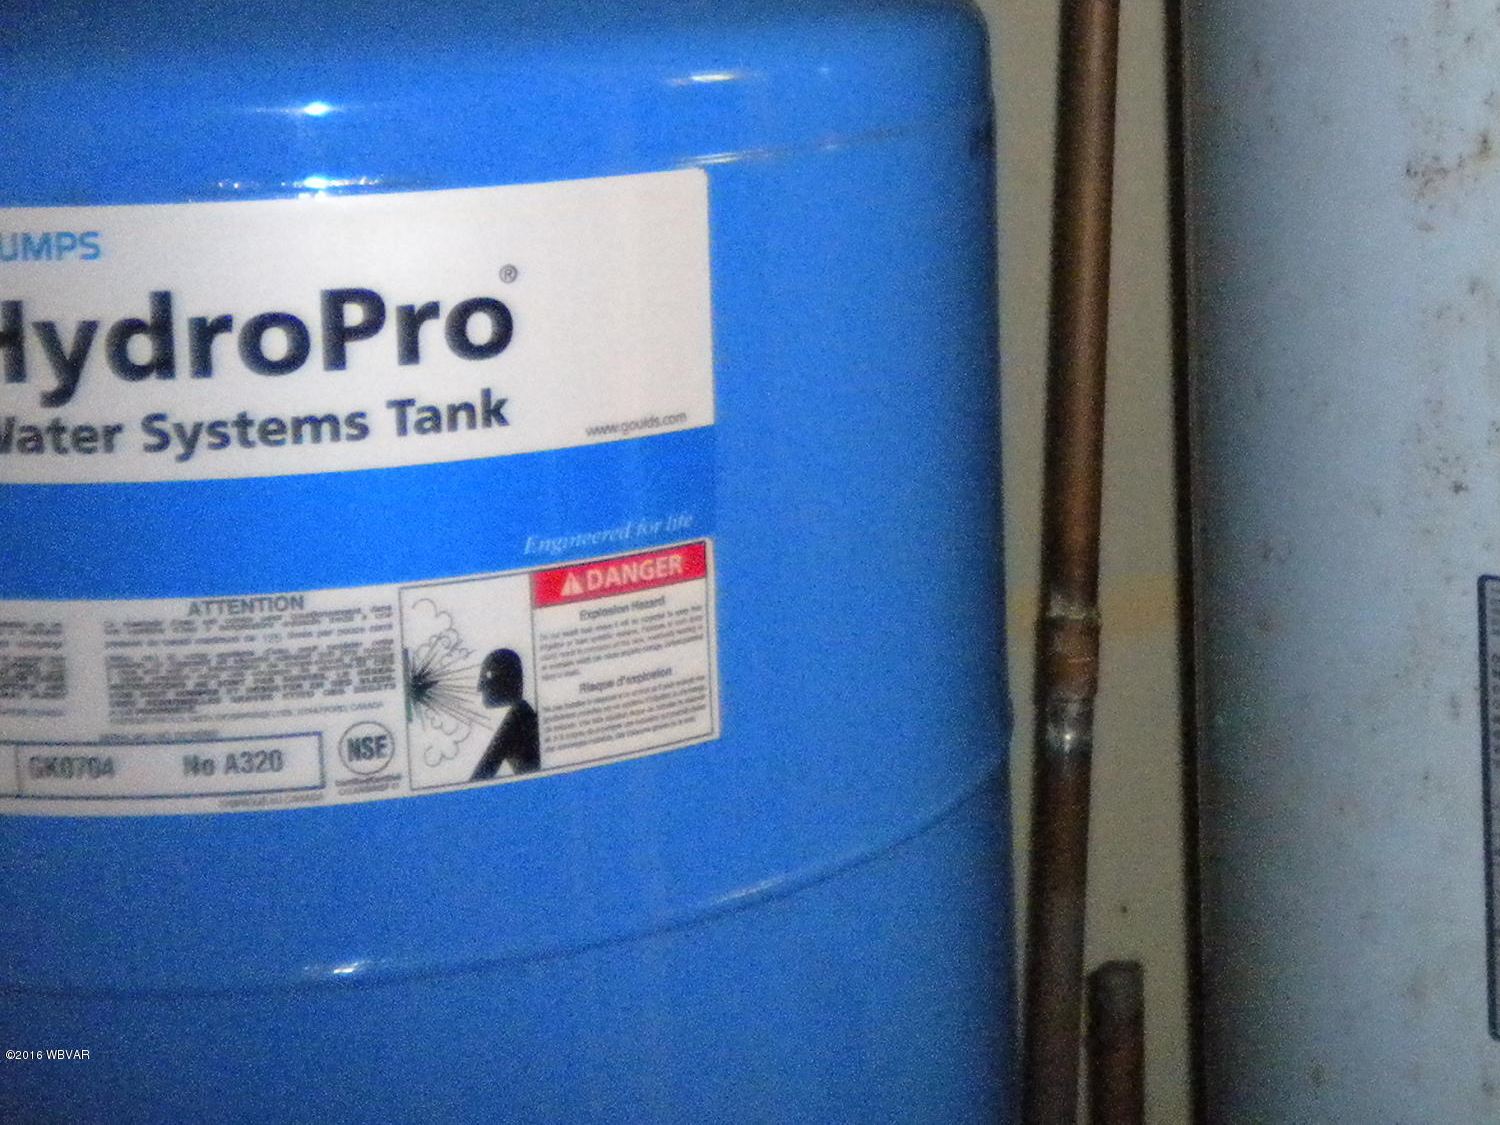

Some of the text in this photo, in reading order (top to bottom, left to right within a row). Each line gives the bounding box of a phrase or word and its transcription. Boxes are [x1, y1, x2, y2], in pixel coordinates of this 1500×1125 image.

[141, 409, 370, 463] Systems
[386, 388, 510, 437] Tank
[585, 412, 687, 436] www.goulds.com
[524, 515, 693, 554] Engineered for life
[586, 554, 684, 591] DANGER
[187, 595, 305, 617] ATTENTION
[579, 604, 629, 621] Explosion
[224, 749, 283, 775] A320
